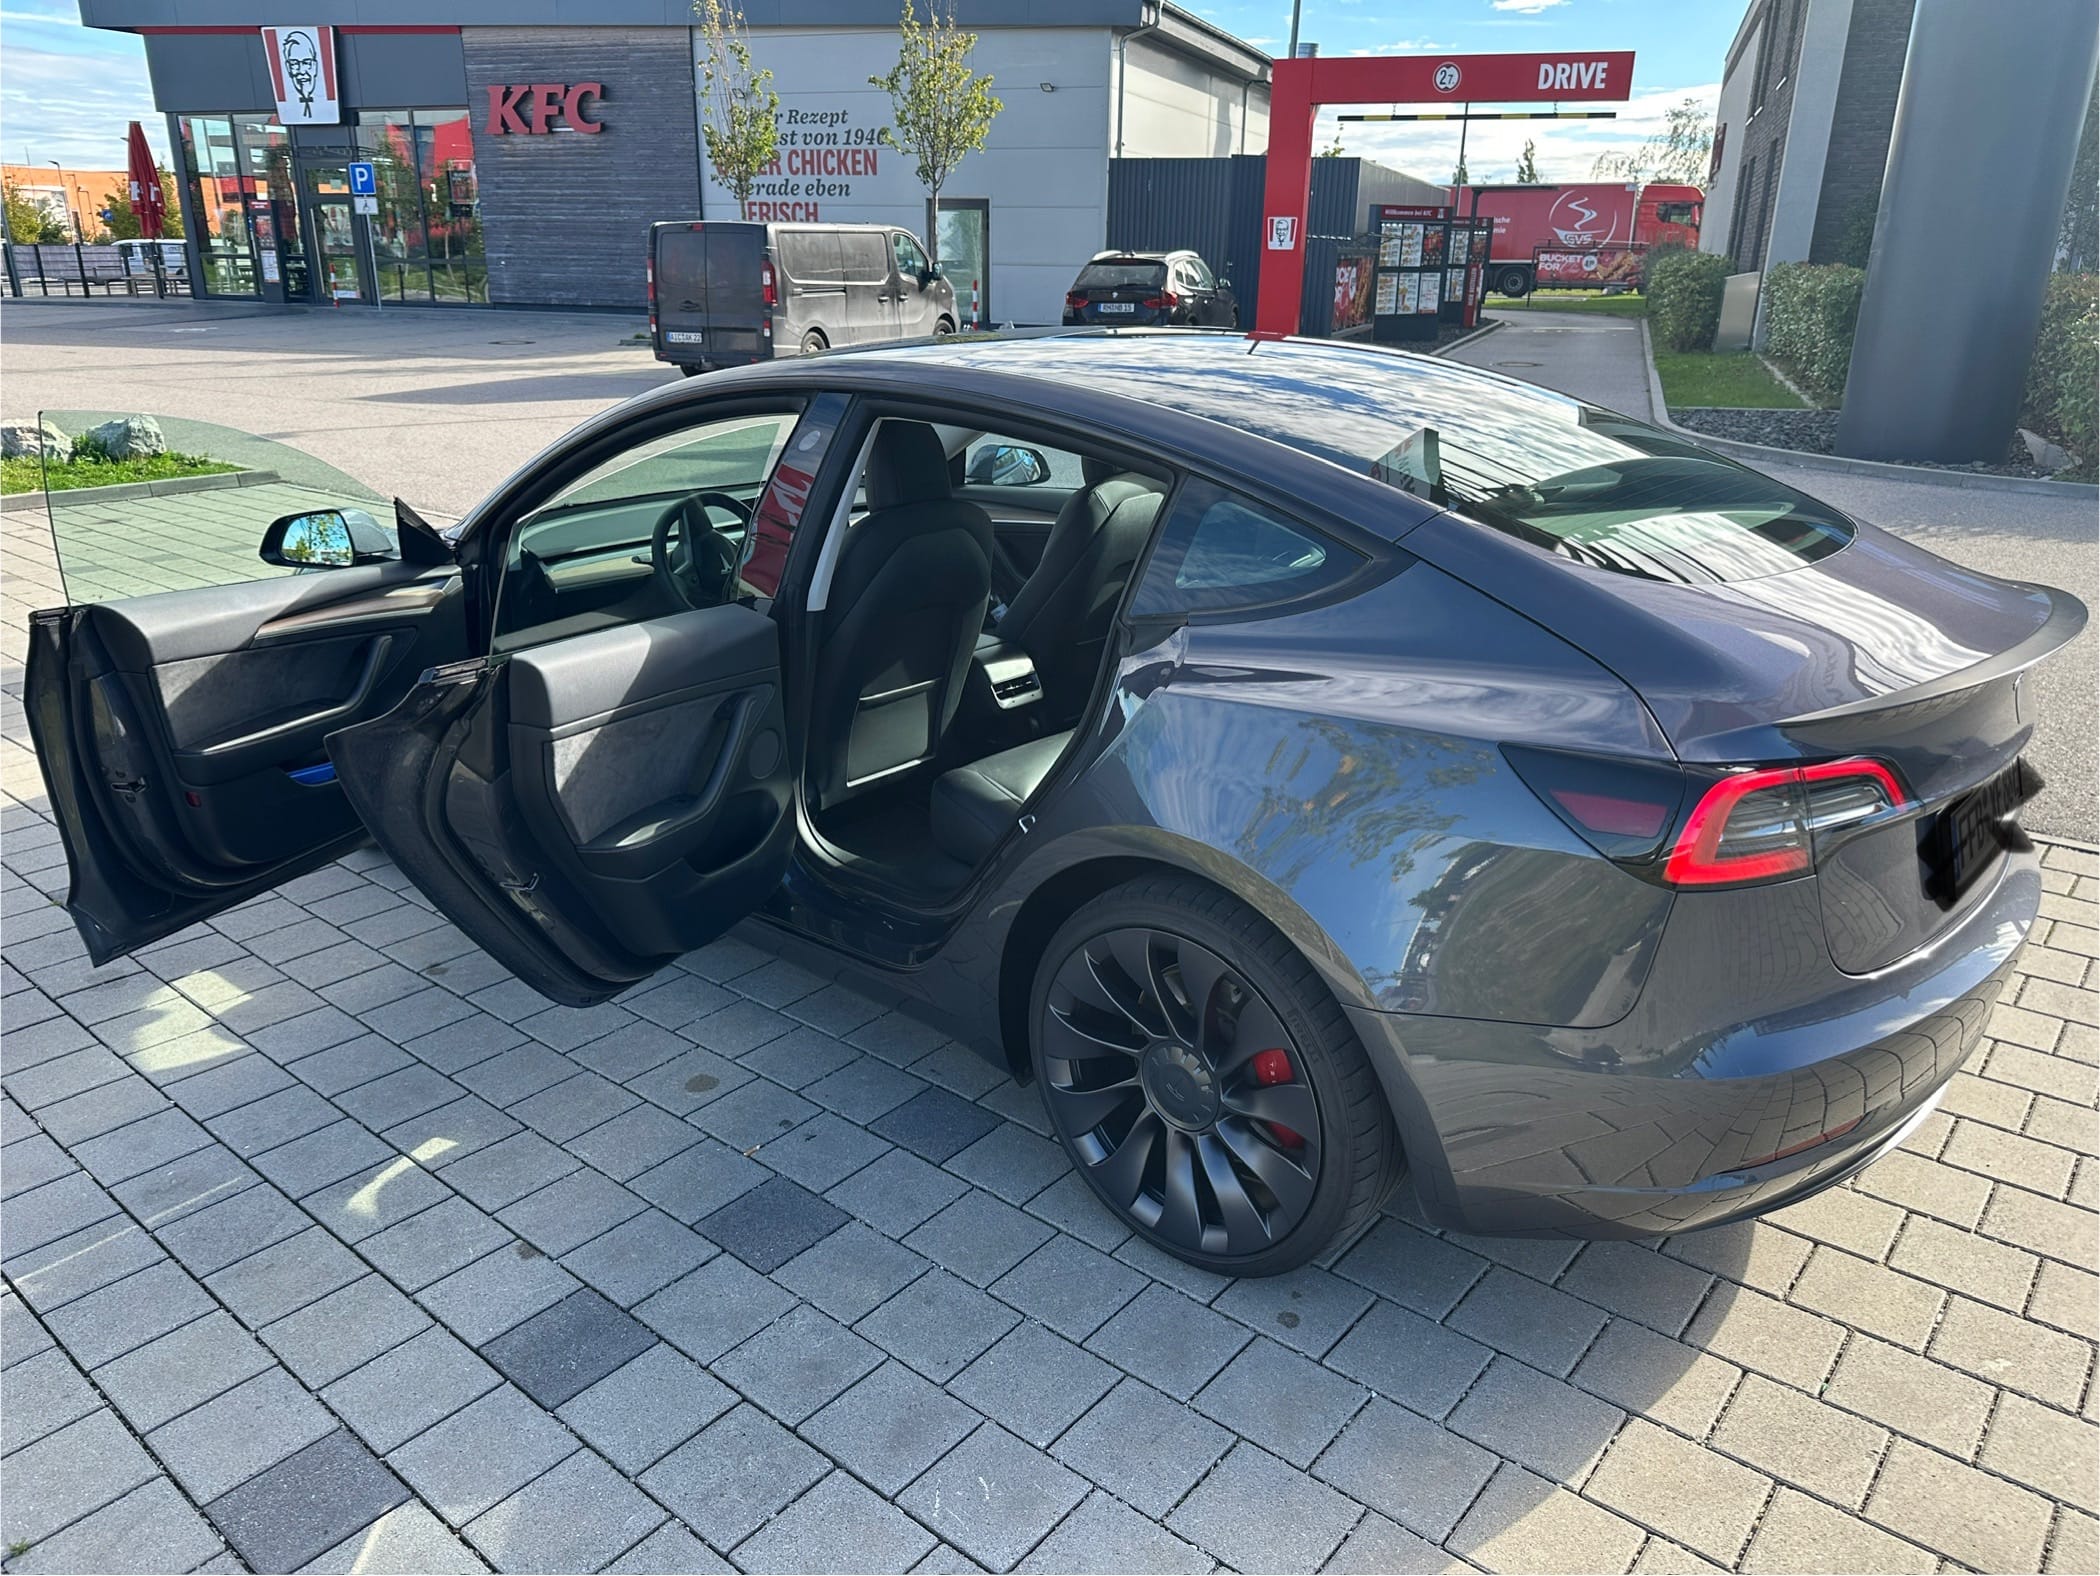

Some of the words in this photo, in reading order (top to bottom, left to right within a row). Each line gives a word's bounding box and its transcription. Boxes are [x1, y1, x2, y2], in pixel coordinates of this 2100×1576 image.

[1537, 62, 1608, 90] DRIVE
[484, 82, 603, 135] KFC
[786, 109, 848, 127] Rezept
[774, 128, 798, 145] st
[802, 132, 839, 146] von
[787, 149, 877, 176] CHICKEN
[355, 167, 368, 190] P
[805, 178, 851, 196] eben
[747, 201, 818, 222] FRISCH
[1566, 234, 1592, 245] GVS
[1538, 253, 1583, 263] BUCKET
[1538, 262, 1560, 271] FOR
